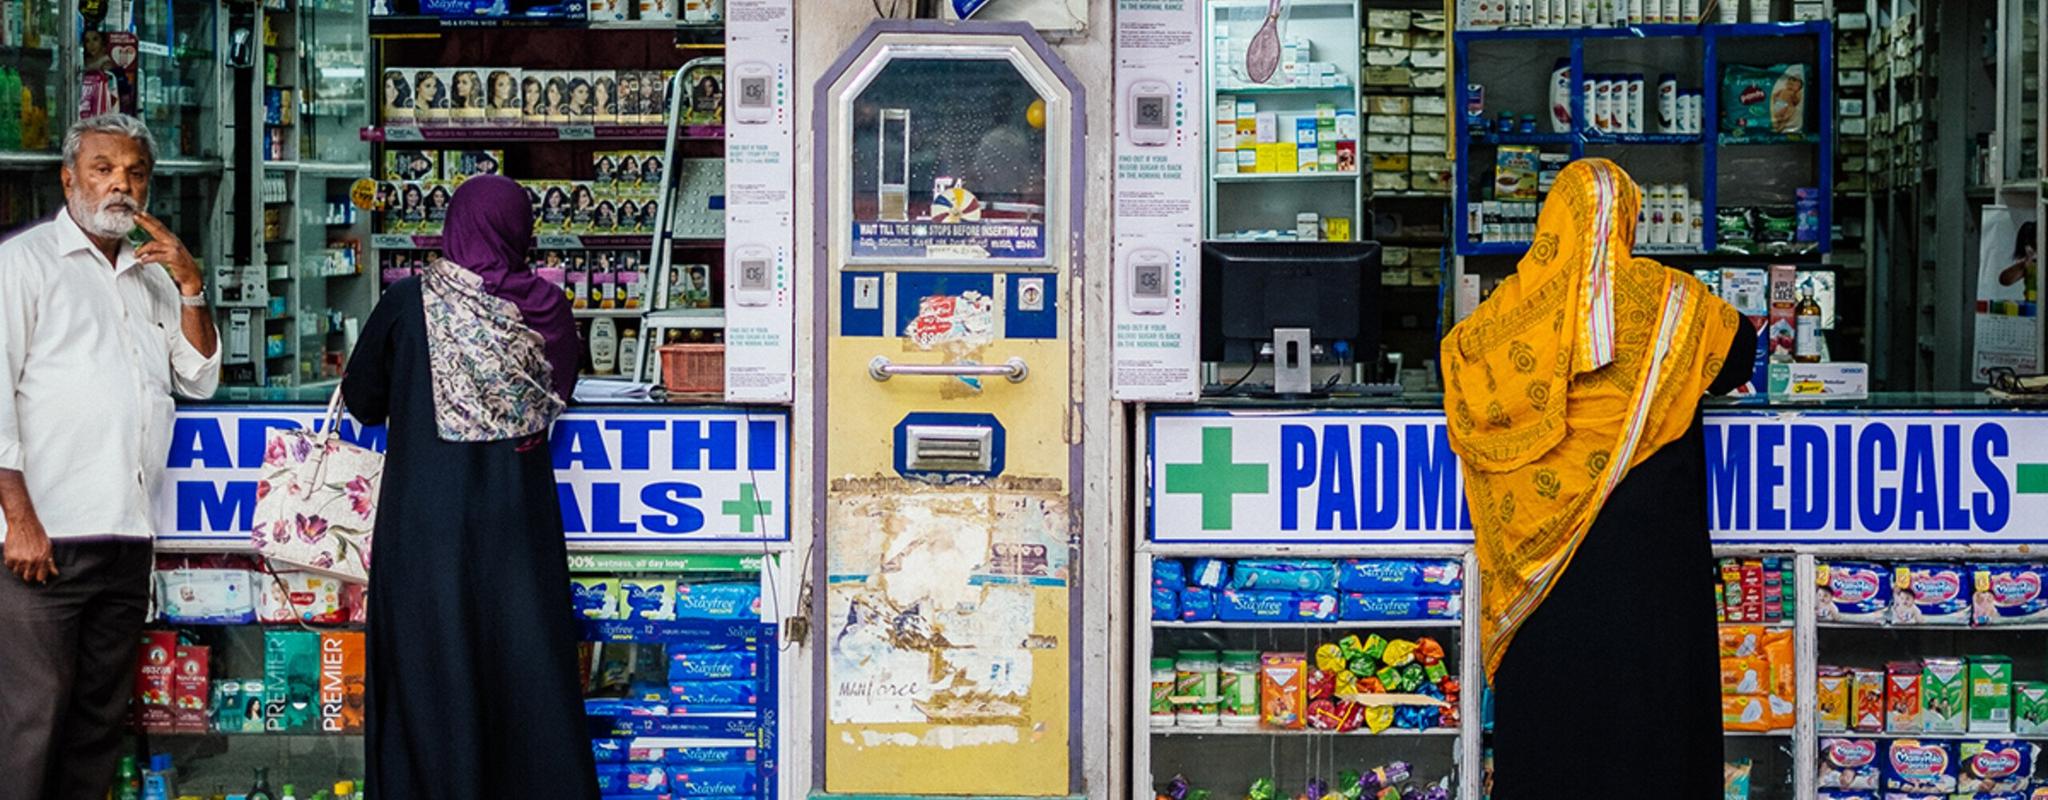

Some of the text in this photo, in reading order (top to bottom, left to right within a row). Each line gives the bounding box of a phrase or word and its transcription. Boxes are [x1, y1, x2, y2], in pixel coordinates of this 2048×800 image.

[860, 224, 878, 236] WAIT
[879, 224, 895, 236] TILL
[895, 224, 910, 236] THE
[929, 224, 952, 237] STOPS
[953, 225, 980, 237] BEFORE
[981, 225, 1019, 238] INSERTING
[1020, 225, 1039, 238] COIN
[1280, 422, 2011, 533] PADM MEDICALS
[685, 595, 736, 614] Stayfree
[1235, 596, 1282, 614] Stayfree
[1362, 597, 1411, 614] Stayfree
[686, 660, 734, 680] Stayfree
[266, 636, 287, 731] PREMIER
[323, 637, 344, 731] PREMIER
[683, 746, 728, 762] Stayfree
[689, 782, 736, 796] Stayfree
